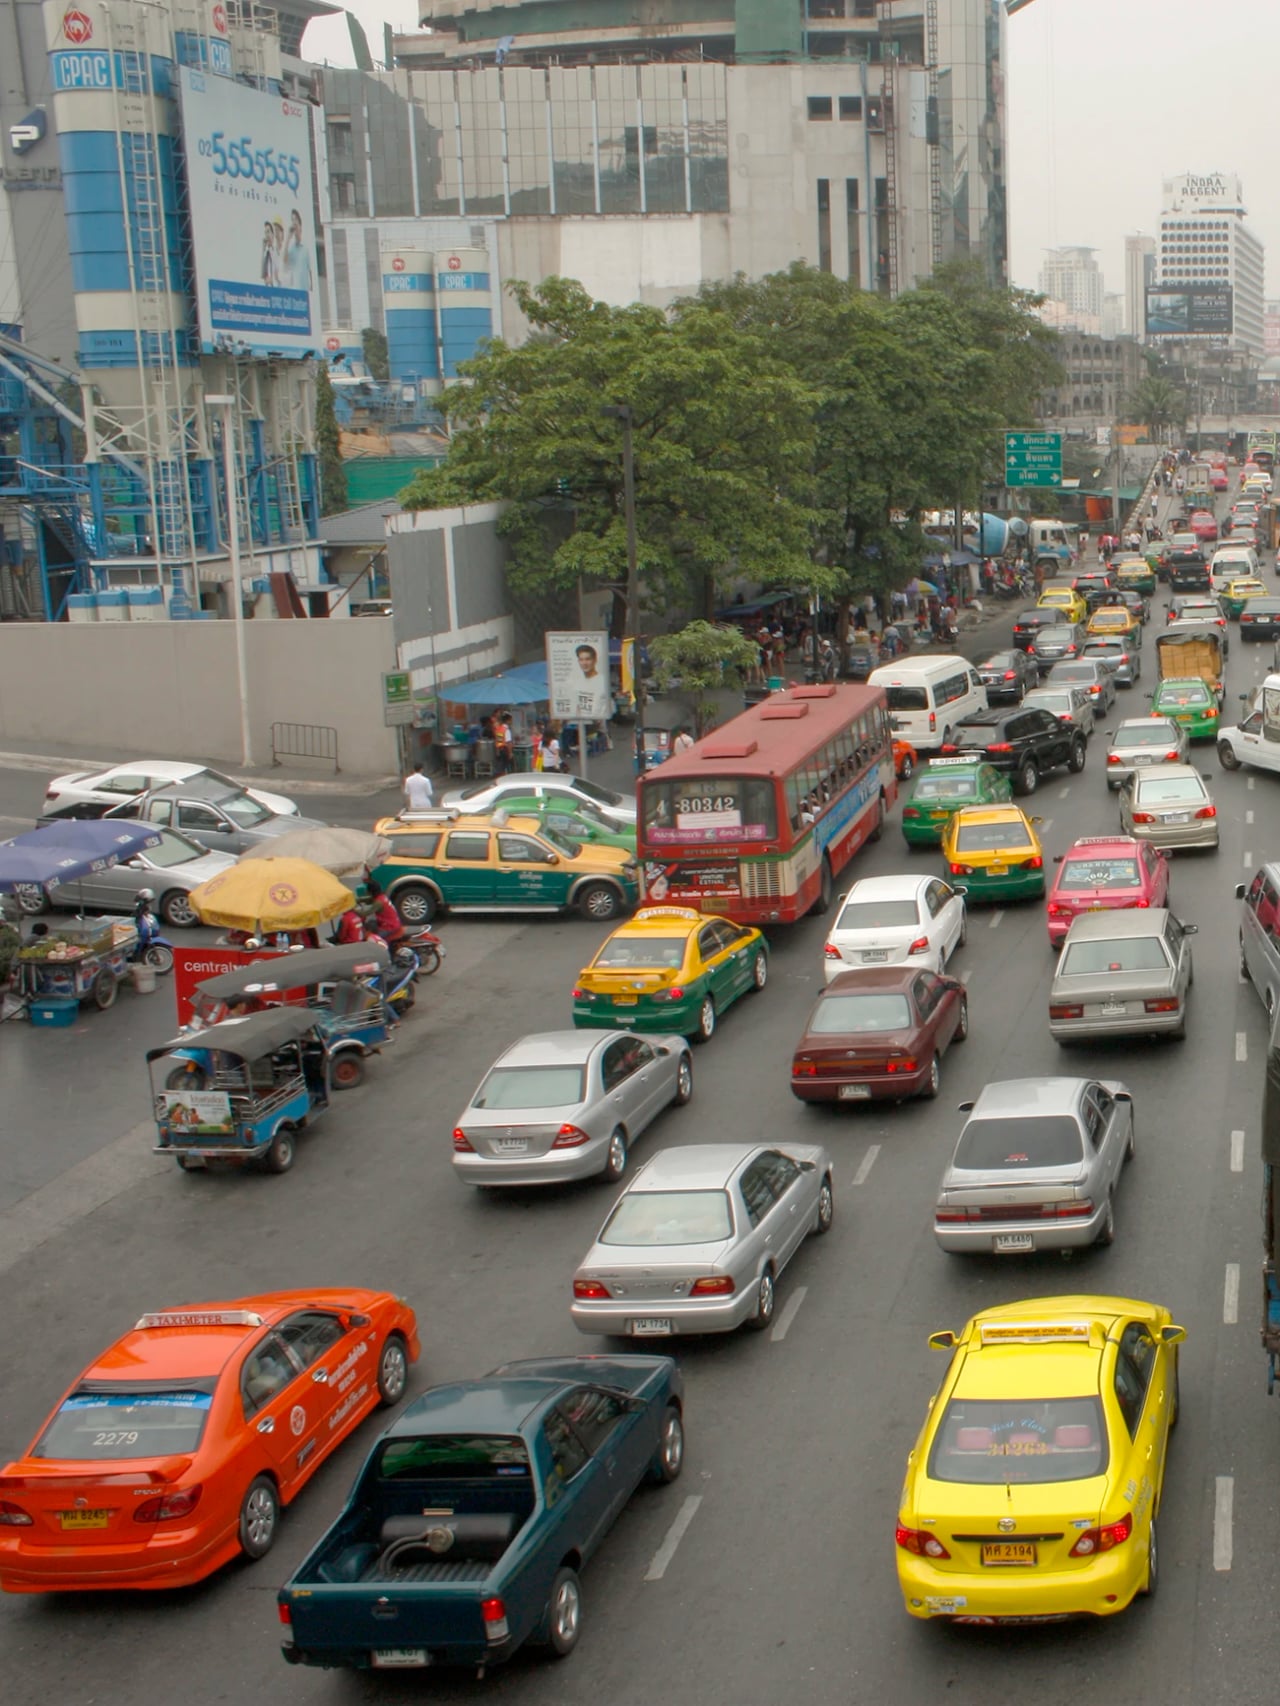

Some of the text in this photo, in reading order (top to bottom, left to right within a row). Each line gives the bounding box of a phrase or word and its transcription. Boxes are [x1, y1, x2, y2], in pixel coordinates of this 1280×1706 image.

[60, 54, 107, 87] CPAC
[198, 139, 212, 157] 02
[1187, 177, 1222, 187] INDRA
[1182, 187, 1227, 196] REGENT
[14, 883, 39, 895] VISA
[92, 1431, 139, 1446] 2279
[1005, 1545, 1033, 1556] 2194
